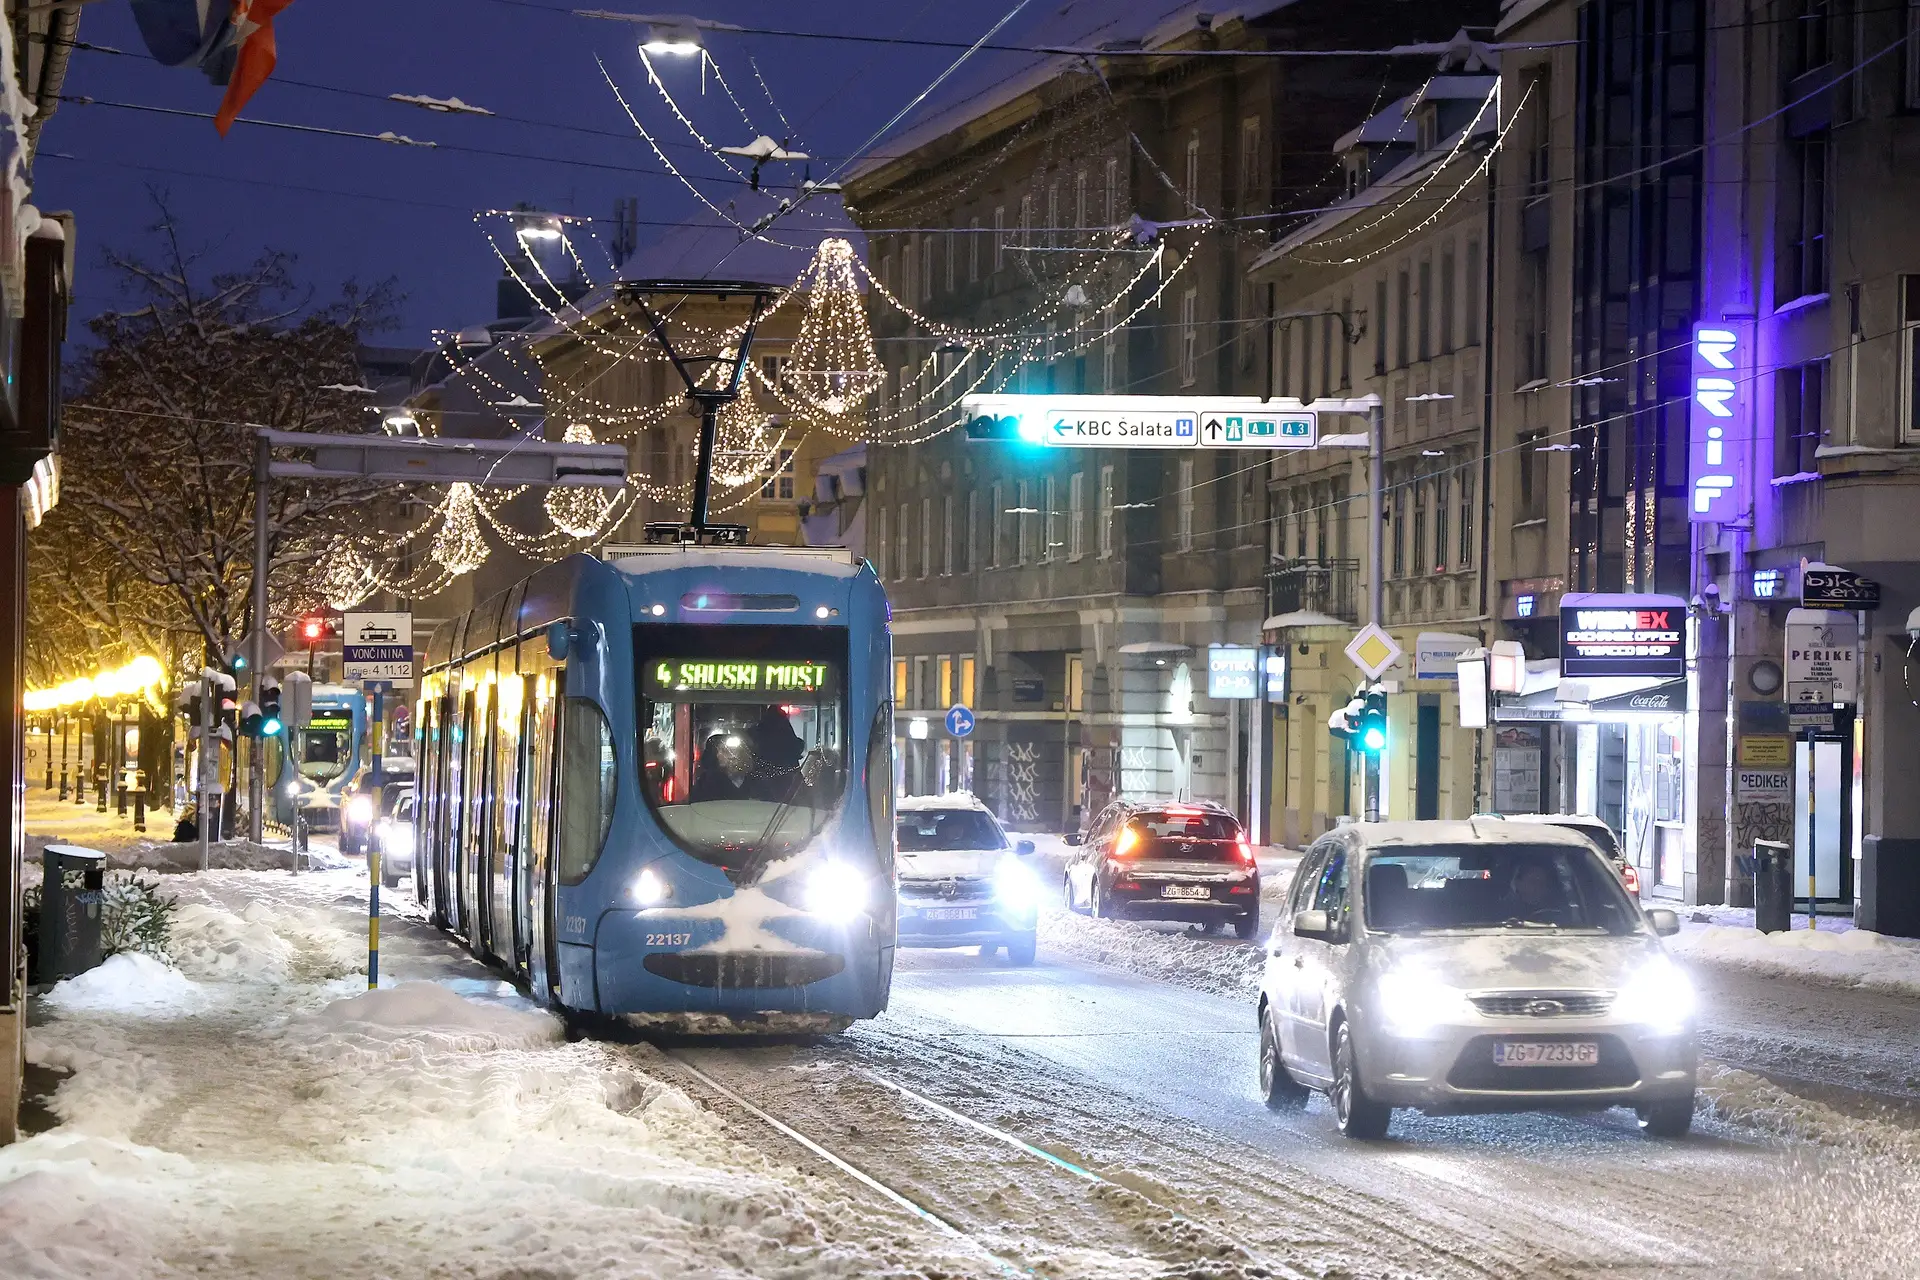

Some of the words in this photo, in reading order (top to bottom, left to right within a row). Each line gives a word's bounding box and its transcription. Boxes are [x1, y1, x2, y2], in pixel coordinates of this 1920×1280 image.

[1077, 420, 1111, 436] KBC
[1118, 417, 1172, 436] Šalata
[1178, 421, 1191, 435] H
[1806, 574, 1874, 588] bike
[1820, 588, 1878, 598] servis
[1576, 610, 1669, 630] WIENEX
[1634, 631, 1680, 642] OFFICE
[352, 647, 404, 659] VONČININA
[1576, 645, 1635, 656] TOBACCO
[1635, 645, 1671, 656] SHOP
[1791, 650, 1852, 661] PERIKE
[1210, 660, 1256, 672] OPTIKA
[657, 663, 672, 688] 4
[680, 664, 758, 689] SAVSKI
[765, 665, 827, 690] MOST
[1167, 887, 1176, 895] ZG
[566, 916, 587, 934] 22137
[645, 933, 692, 946] 22137
[1507, 1044, 1525, 1061] ZG
